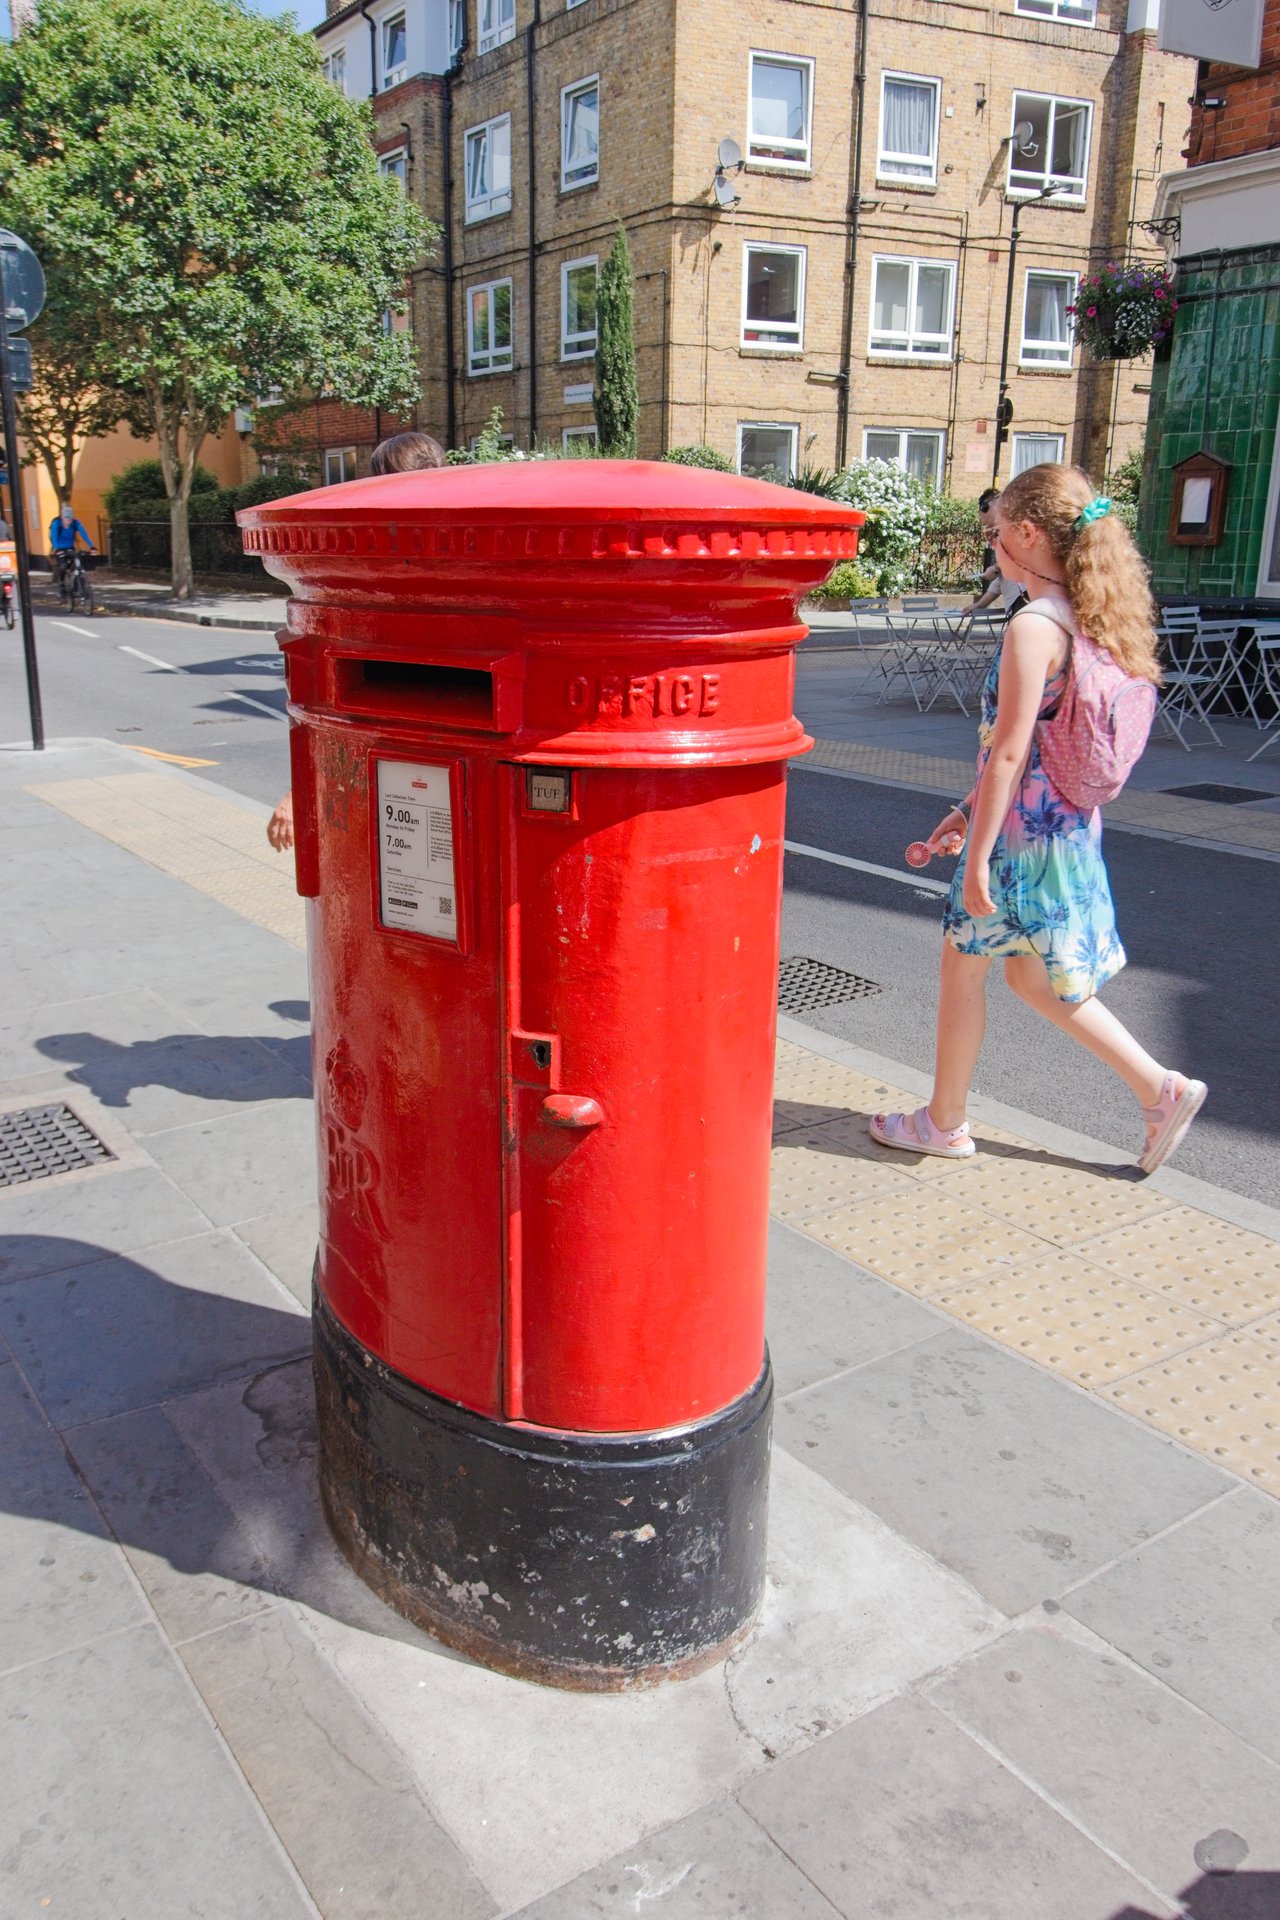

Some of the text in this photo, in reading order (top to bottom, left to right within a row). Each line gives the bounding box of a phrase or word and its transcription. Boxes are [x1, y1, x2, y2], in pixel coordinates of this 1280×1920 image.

[566, 674, 721, 717] OFFICE
[534, 787, 560, 799] TUE
[386, 805, 419, 825] 9.00am
[386, 835, 411, 850] 7.00am
